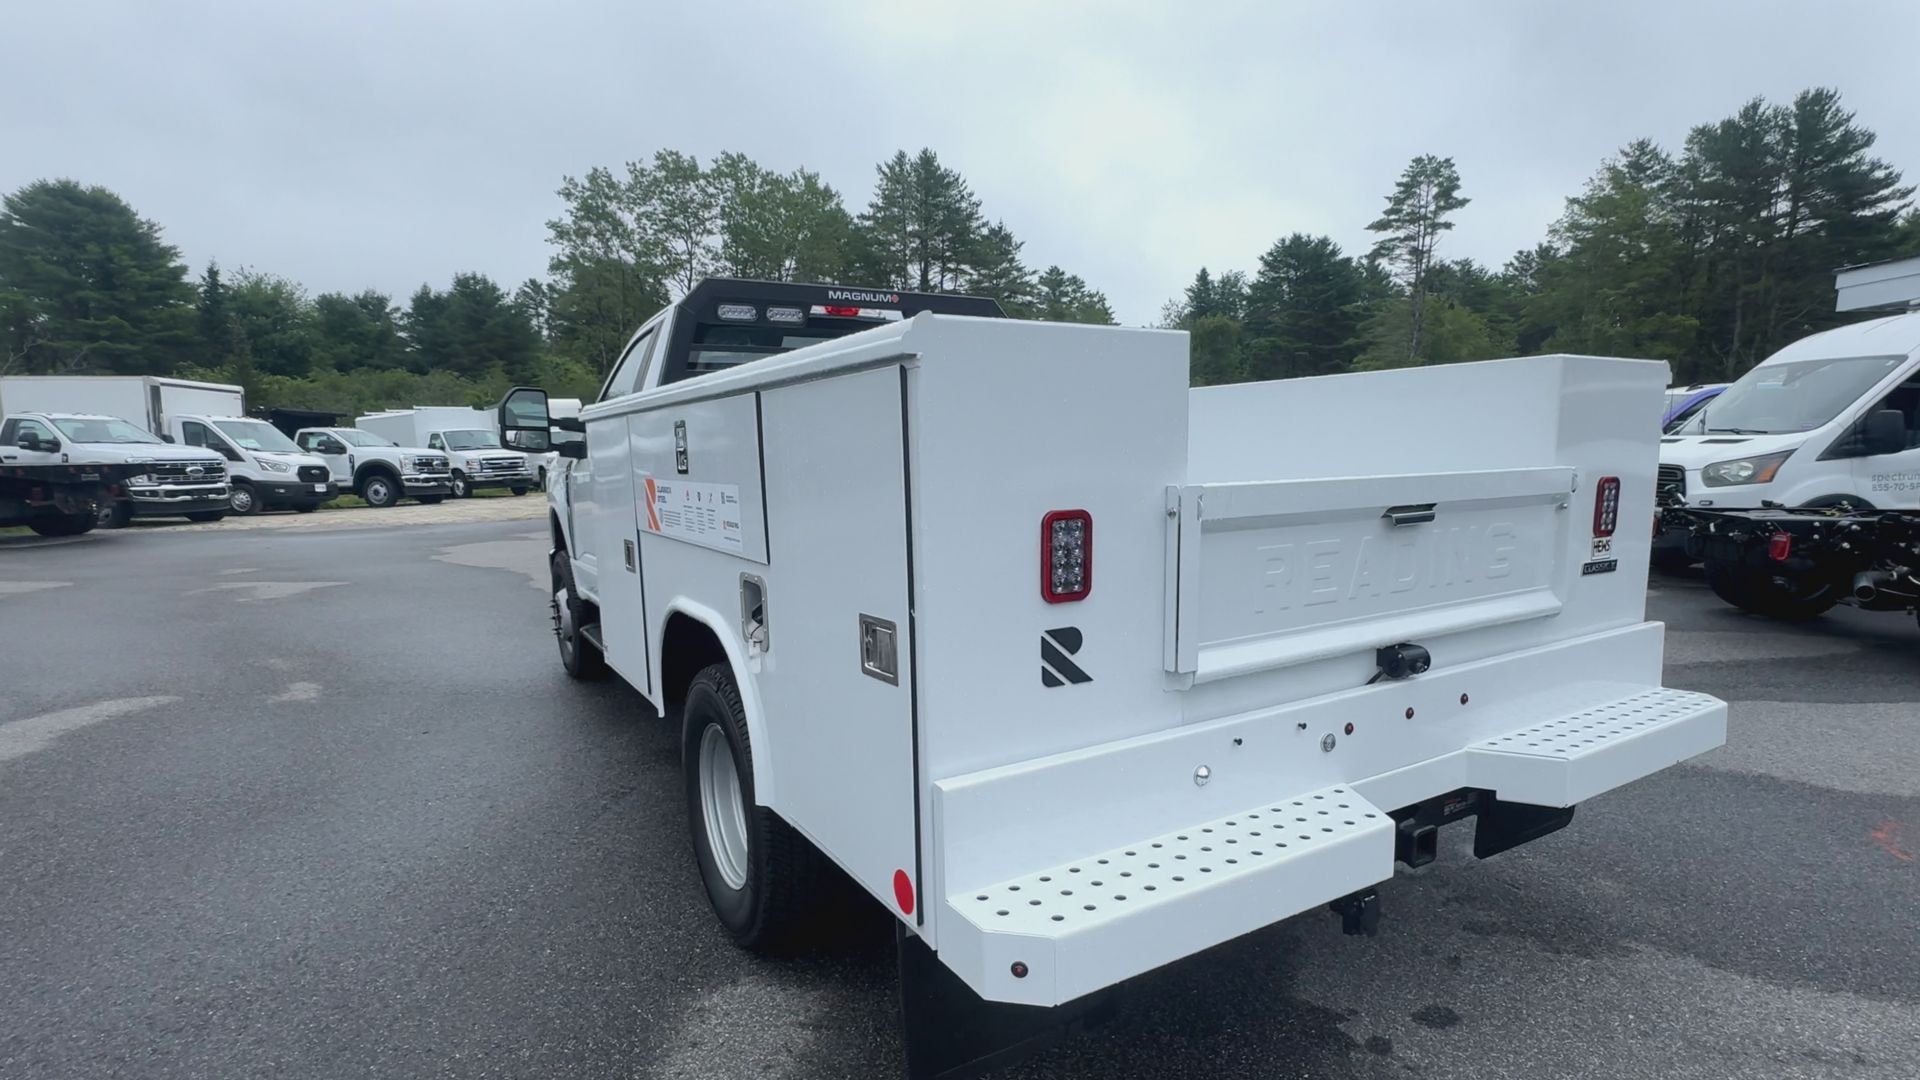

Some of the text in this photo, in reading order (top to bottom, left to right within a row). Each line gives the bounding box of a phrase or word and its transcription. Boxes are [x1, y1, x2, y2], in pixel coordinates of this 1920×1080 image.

[828, 290, 892, 303] MAGNUM
[1593, 539, 1611, 553] HEWS
[1254, 523, 1517, 615] READING
